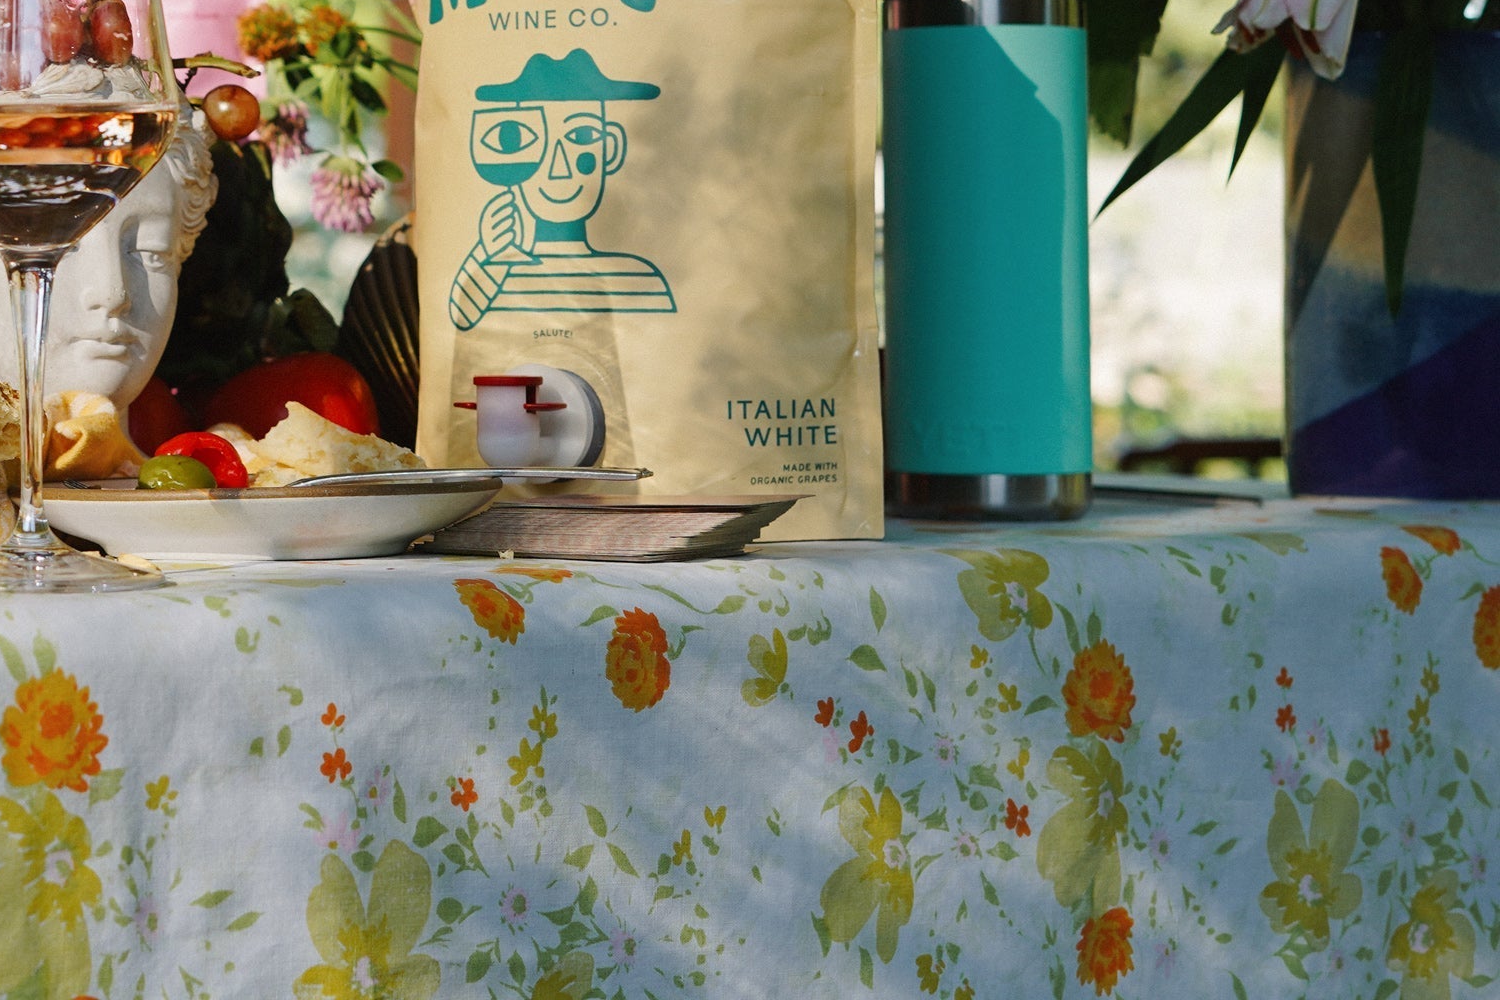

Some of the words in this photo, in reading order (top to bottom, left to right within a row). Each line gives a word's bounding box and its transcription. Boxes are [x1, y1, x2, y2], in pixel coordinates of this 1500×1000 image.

[488, 9, 557, 31] WINE
[567, 7, 619, 28] CO.
[532, 328, 573, 339] SALUTE!
[727, 397, 836, 420] ITALIAN
[744, 424, 838, 447] WHITE
[782, 463, 812, 473] MADE
[814, 461, 838, 471] WITH
[750, 475, 794, 486] ORGANIC
[797, 473, 838, 484] GRAPES
